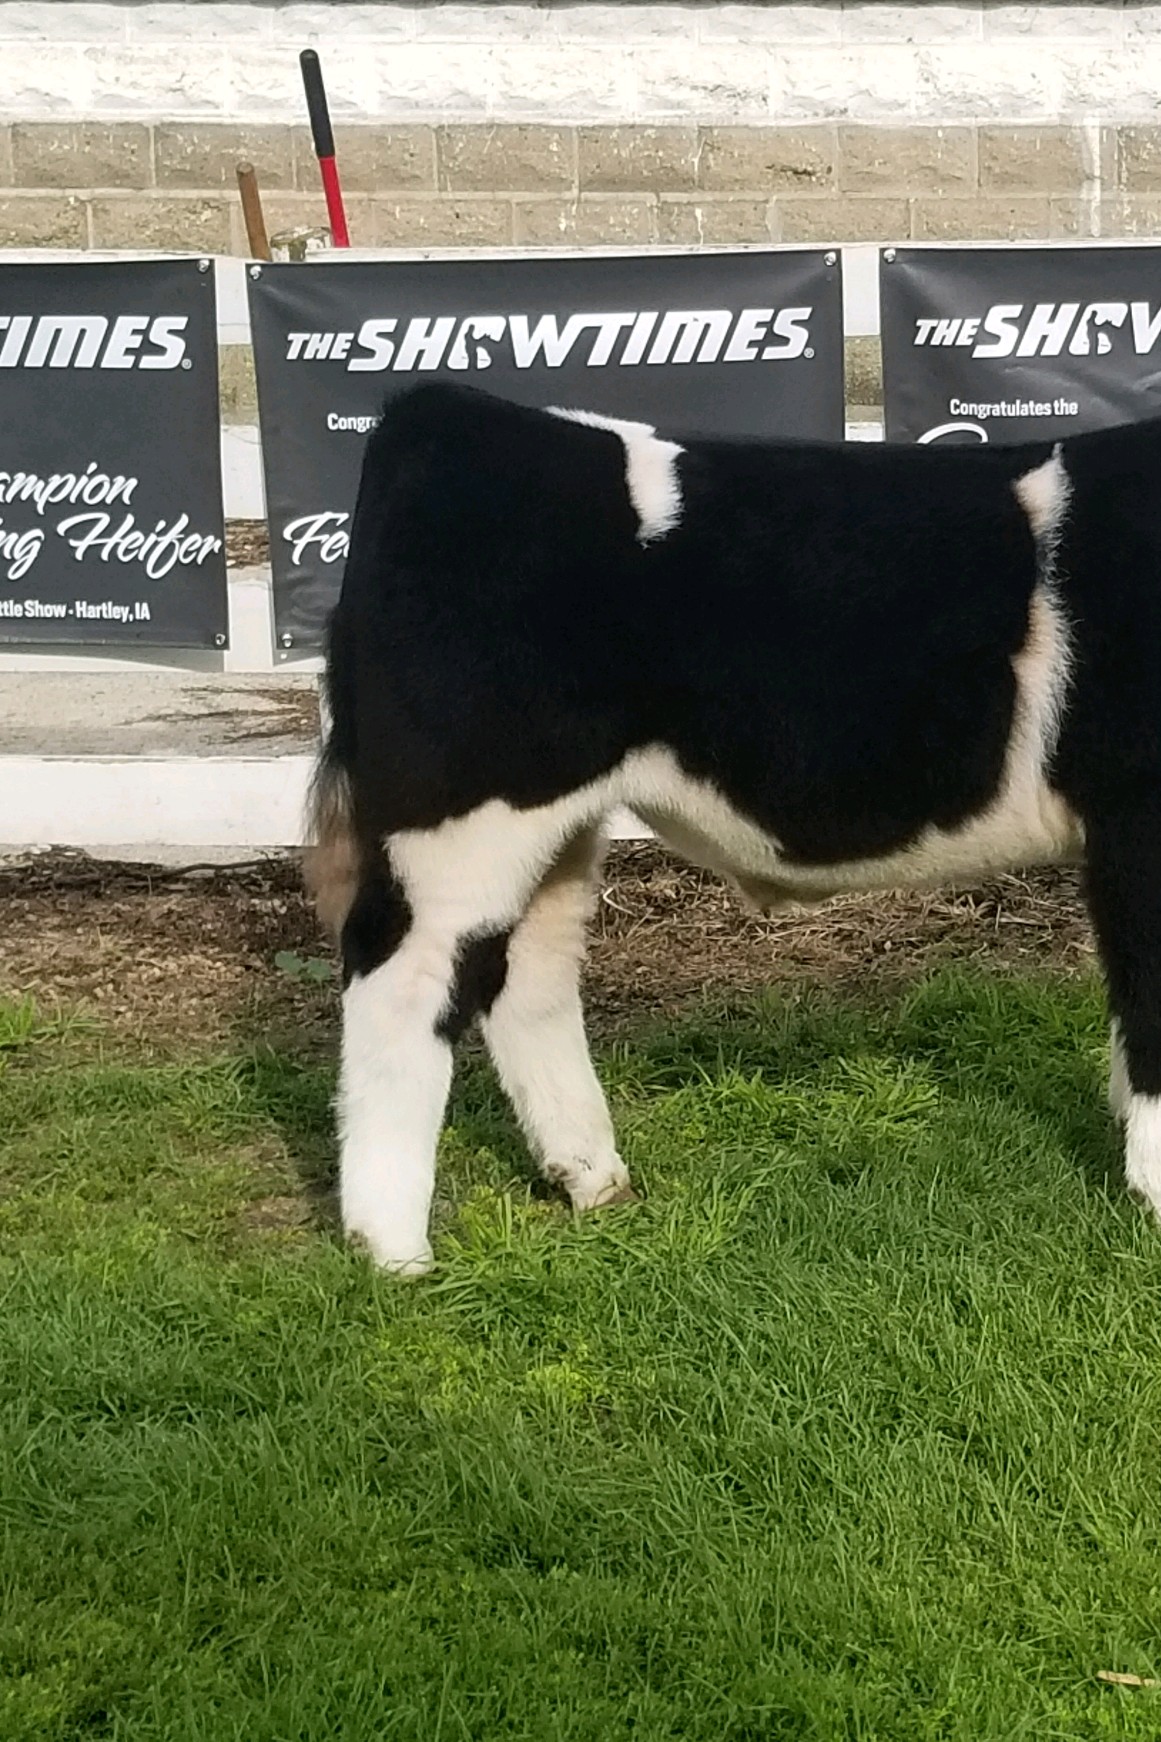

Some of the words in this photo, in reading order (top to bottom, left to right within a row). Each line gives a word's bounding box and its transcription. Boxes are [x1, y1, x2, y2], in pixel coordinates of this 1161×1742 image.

[0, 315, 188, 369] IMES
[913, 317, 981, 346] THE
[286, 332, 355, 360] THE
[950, 398, 1051, 419] Congratulates
[1053, 398, 1078, 415] the
[56, 511, 222, 580] Heifer
[24, 599, 66, 618] Show
[135, 602, 150, 620] IA
